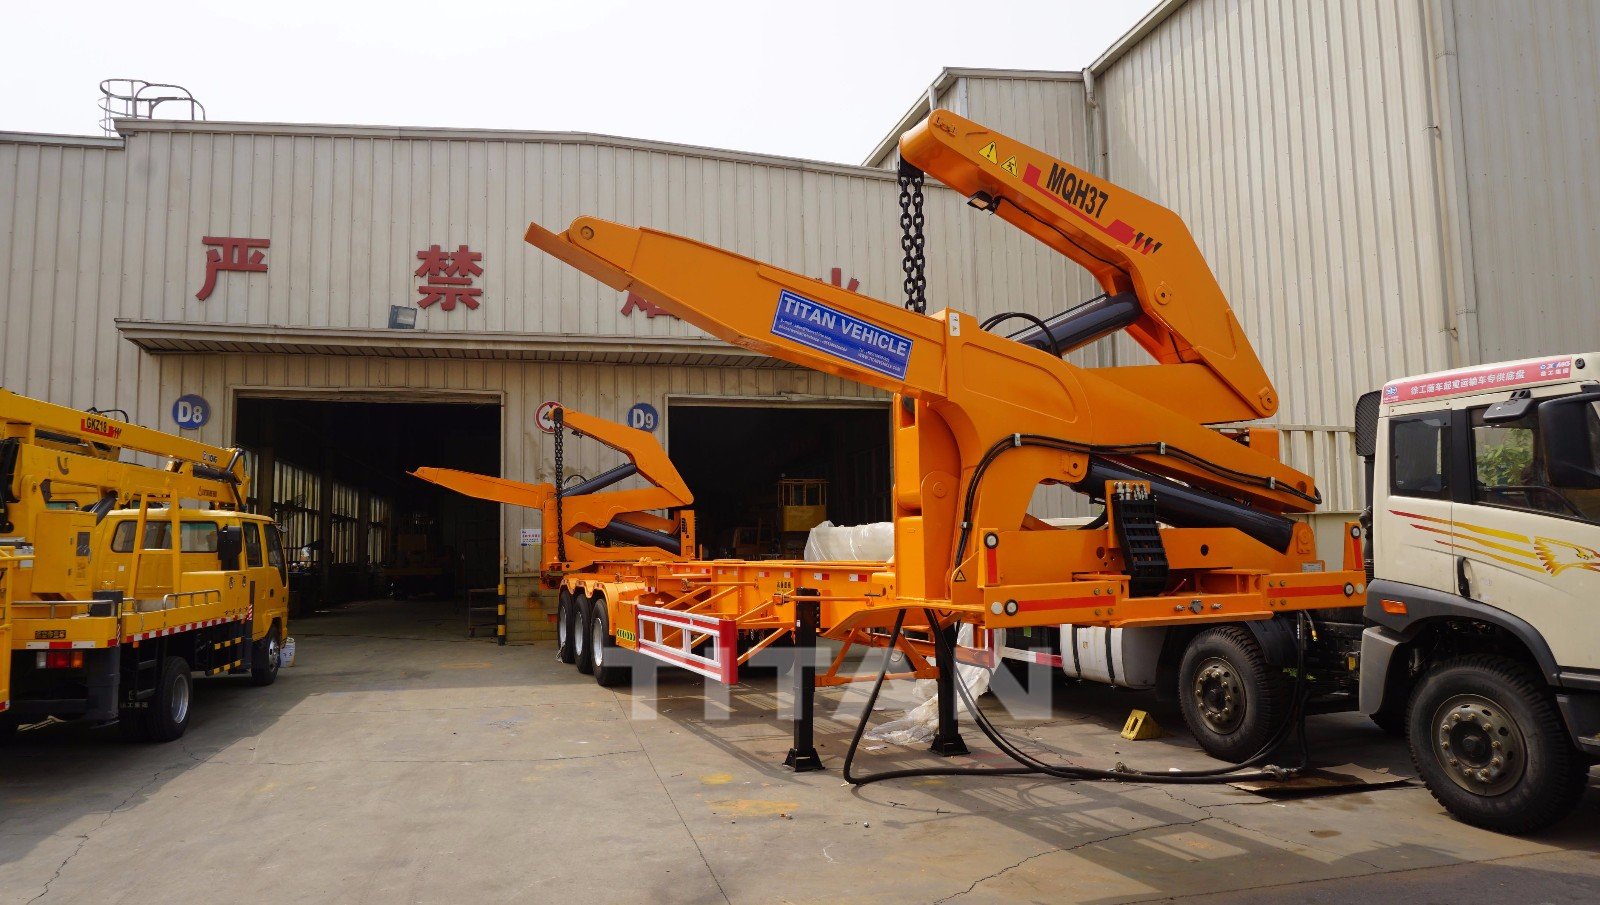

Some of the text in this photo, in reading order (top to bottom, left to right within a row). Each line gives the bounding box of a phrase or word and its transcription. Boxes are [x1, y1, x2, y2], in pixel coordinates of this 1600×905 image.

[1046, 163, 1109, 219] MQH37
[784, 297, 837, 330] TITAN
[841, 319, 908, 357] VEHICLE
[177, 401, 204, 424] D8
[632, 408, 655, 429] D9
[86, 417, 108, 433] GKZ18
